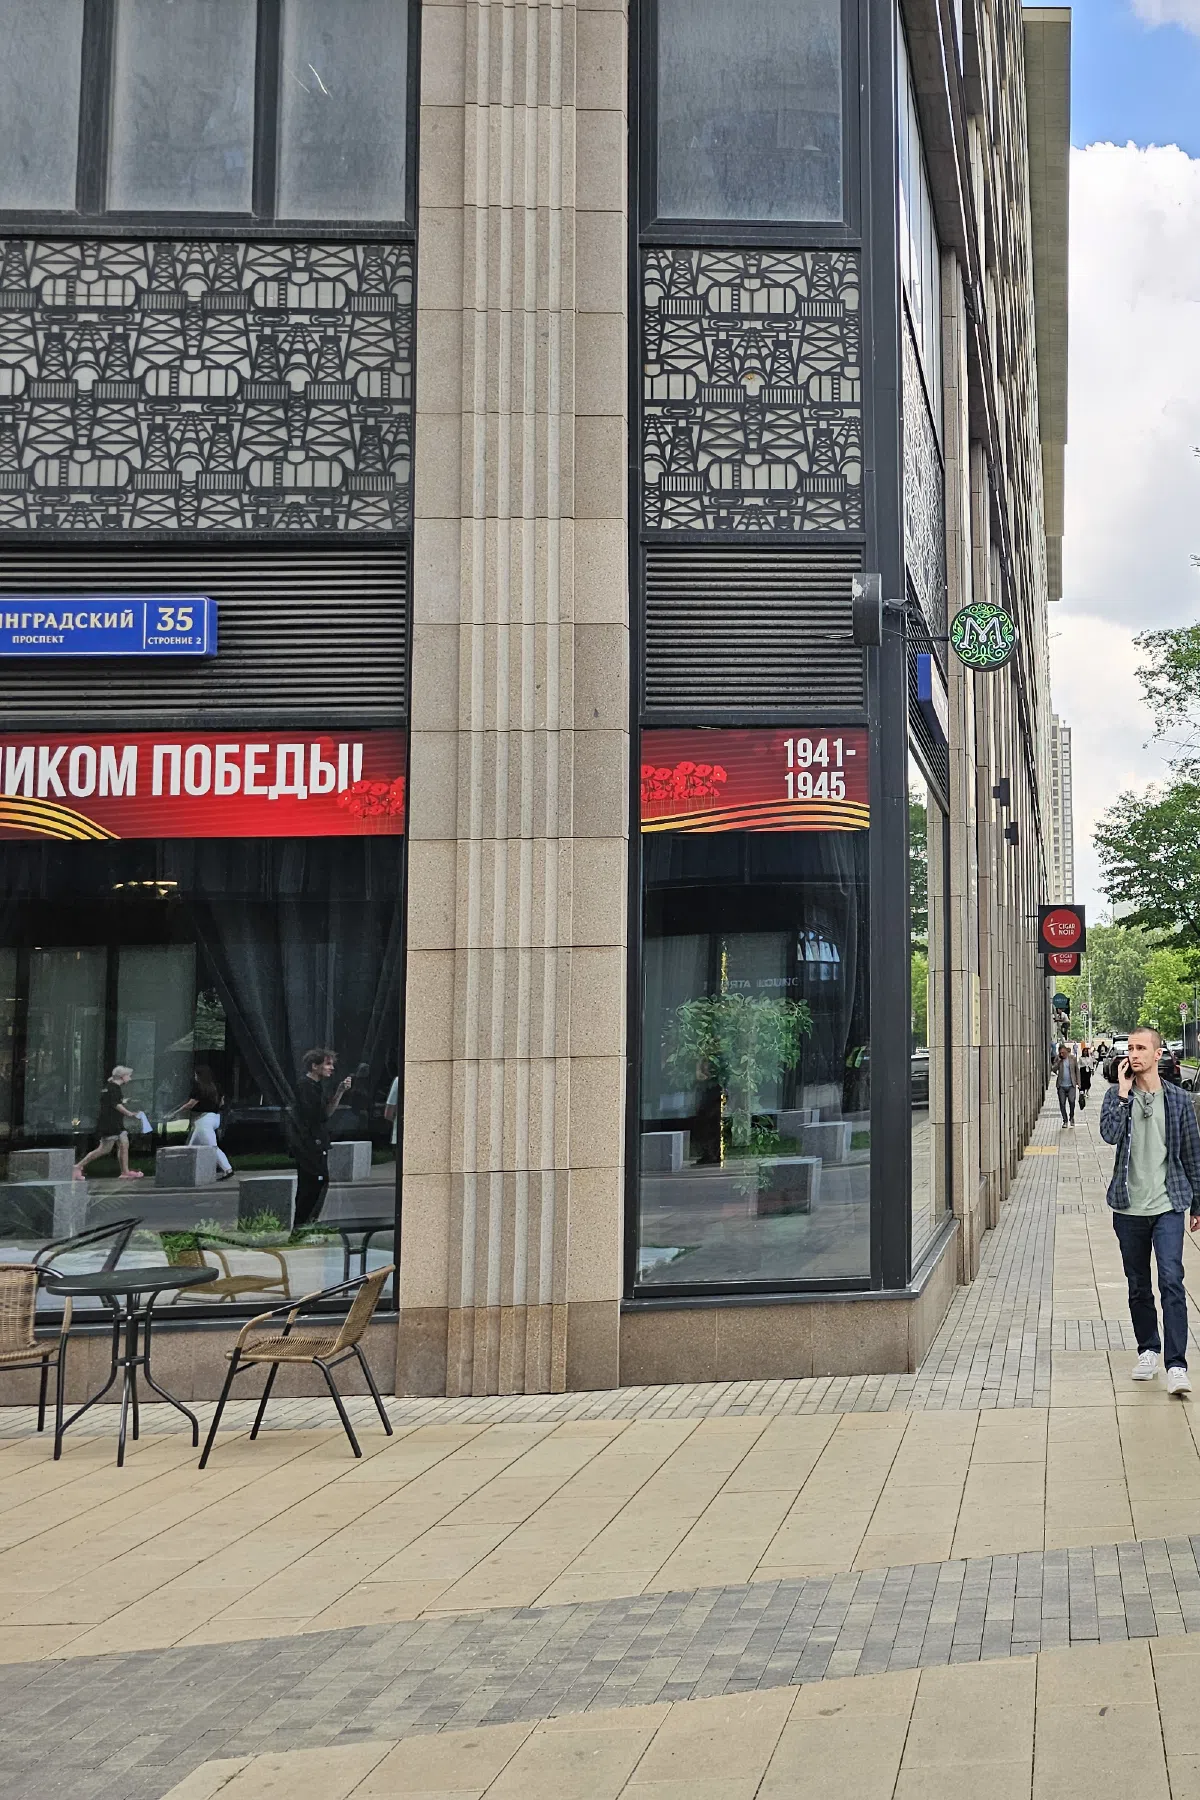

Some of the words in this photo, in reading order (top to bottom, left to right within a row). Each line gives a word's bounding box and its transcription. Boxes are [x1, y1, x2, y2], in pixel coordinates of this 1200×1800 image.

[0, 609, 134, 631] НГРАДСКИЙ
[156, 607, 194, 632] 35
[12, 635, 65, 644] ПРОСПЕКТ
[147, 636, 193, 645] СТРОЕНИЕ
[195, 636, 202, 645] 2
[783, 738, 856, 768] 1941-
[0, 745, 138, 798] ИКОМ
[784, 771, 846, 801] 1945
